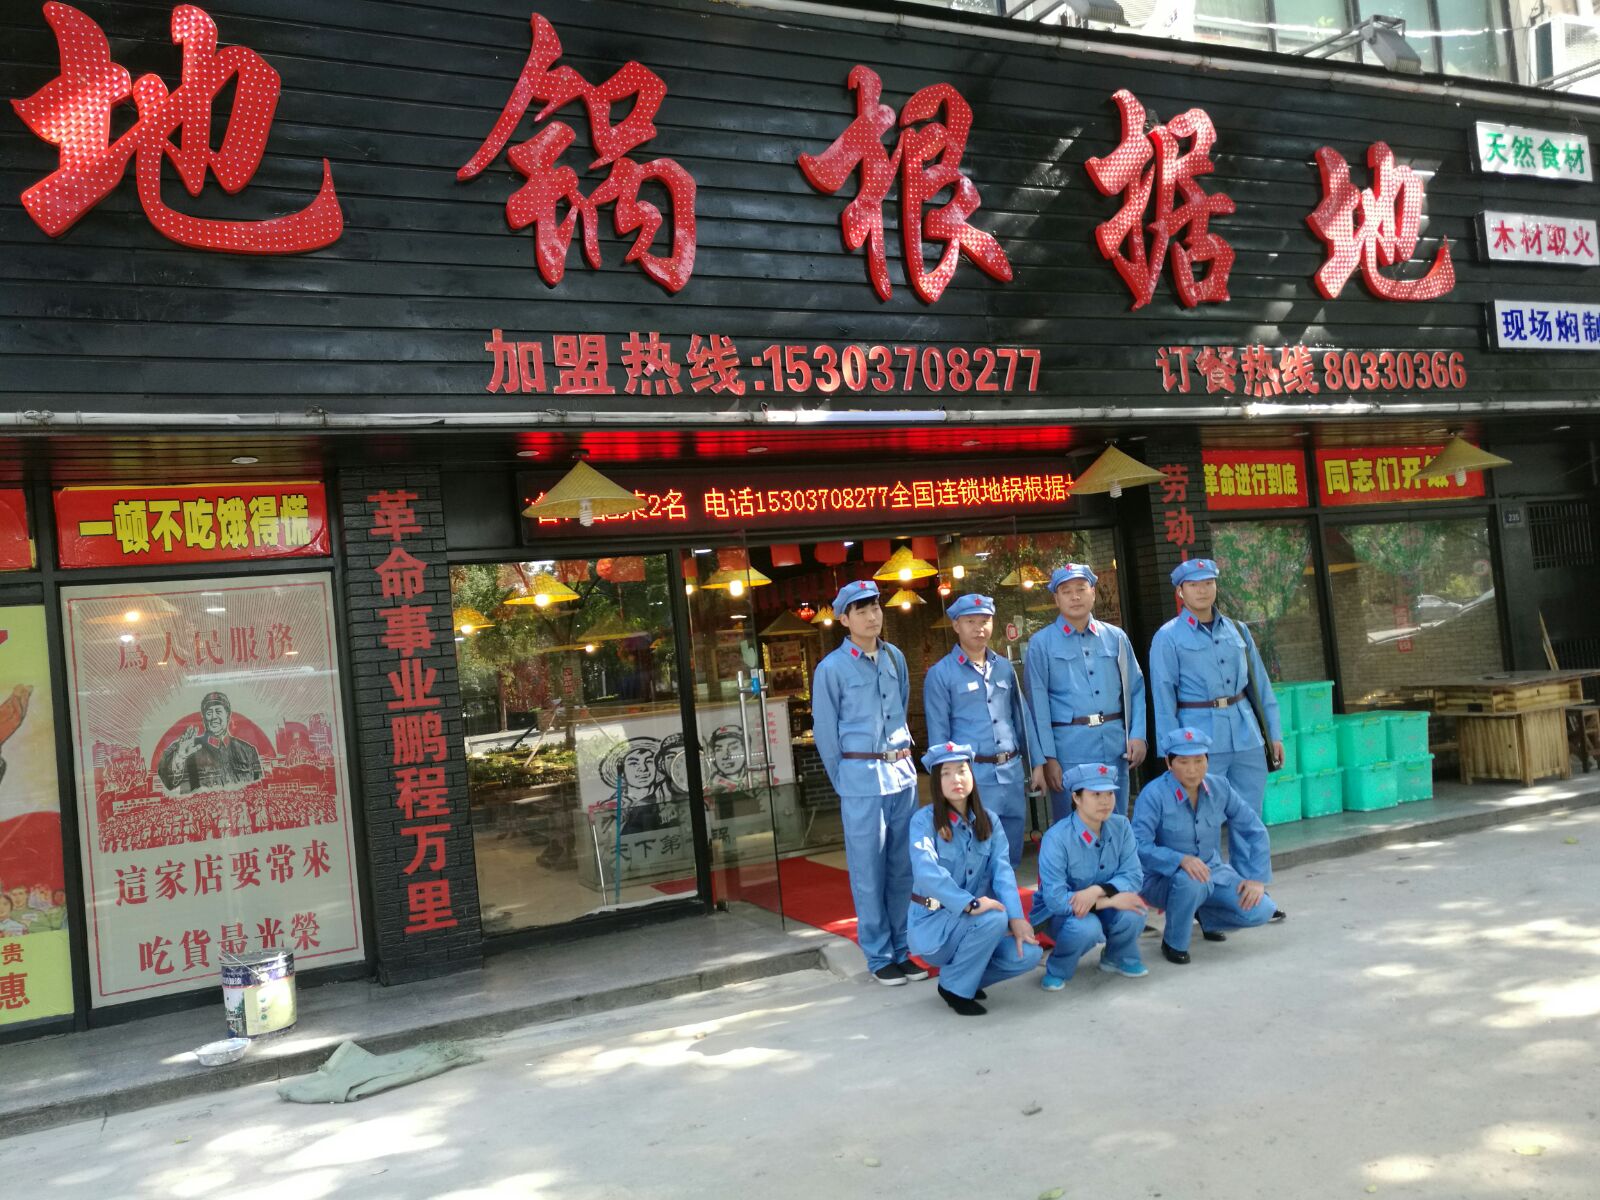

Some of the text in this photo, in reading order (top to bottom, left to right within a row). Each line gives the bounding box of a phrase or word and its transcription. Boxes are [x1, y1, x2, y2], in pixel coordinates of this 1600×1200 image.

[12, 1, 1457, 311] 地锅根据地
[1485, 132, 1585, 174] 天然食材
[1492, 219, 1594, 258] 木材取火
[1502, 309, 1600, 343] 现场焖制
[485, 328, 1041, 395] 加盟热线:15303708277
[1203, 463, 1298, 496] 革命进行到底
[79, 494, 312, 554] 一顿不吃饿得慌
[367, 489, 459, 934] 革命事业鹏程万里
[114, 839, 332, 907] 這家店要常來
[138, 911, 321, 976] 吃貨最光榮
